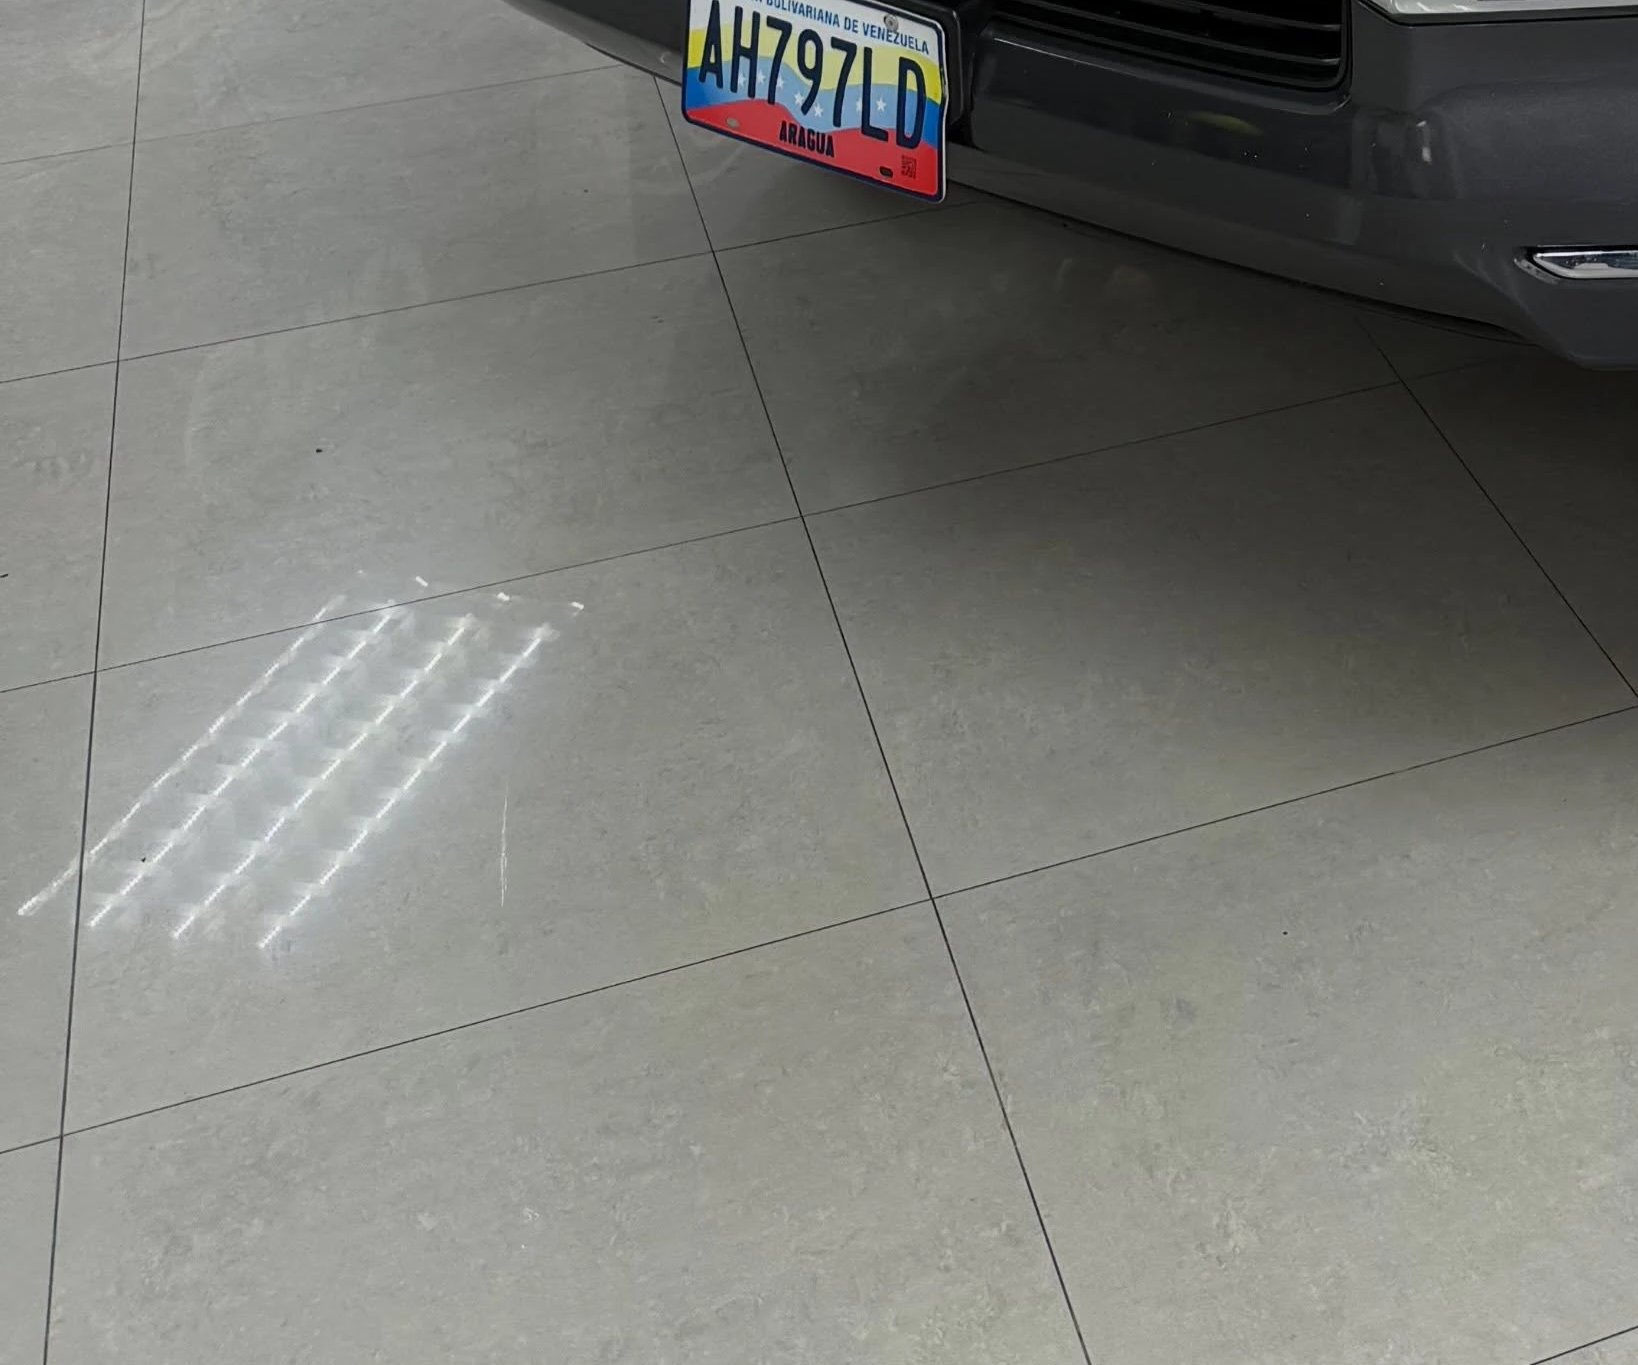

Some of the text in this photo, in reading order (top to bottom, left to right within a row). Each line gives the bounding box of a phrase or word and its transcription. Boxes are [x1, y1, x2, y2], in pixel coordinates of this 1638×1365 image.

[844, 16, 859, 34] DE
[862, 21, 930, 56] VENEZUELA
[779, 120, 836, 158] ARAGUA
